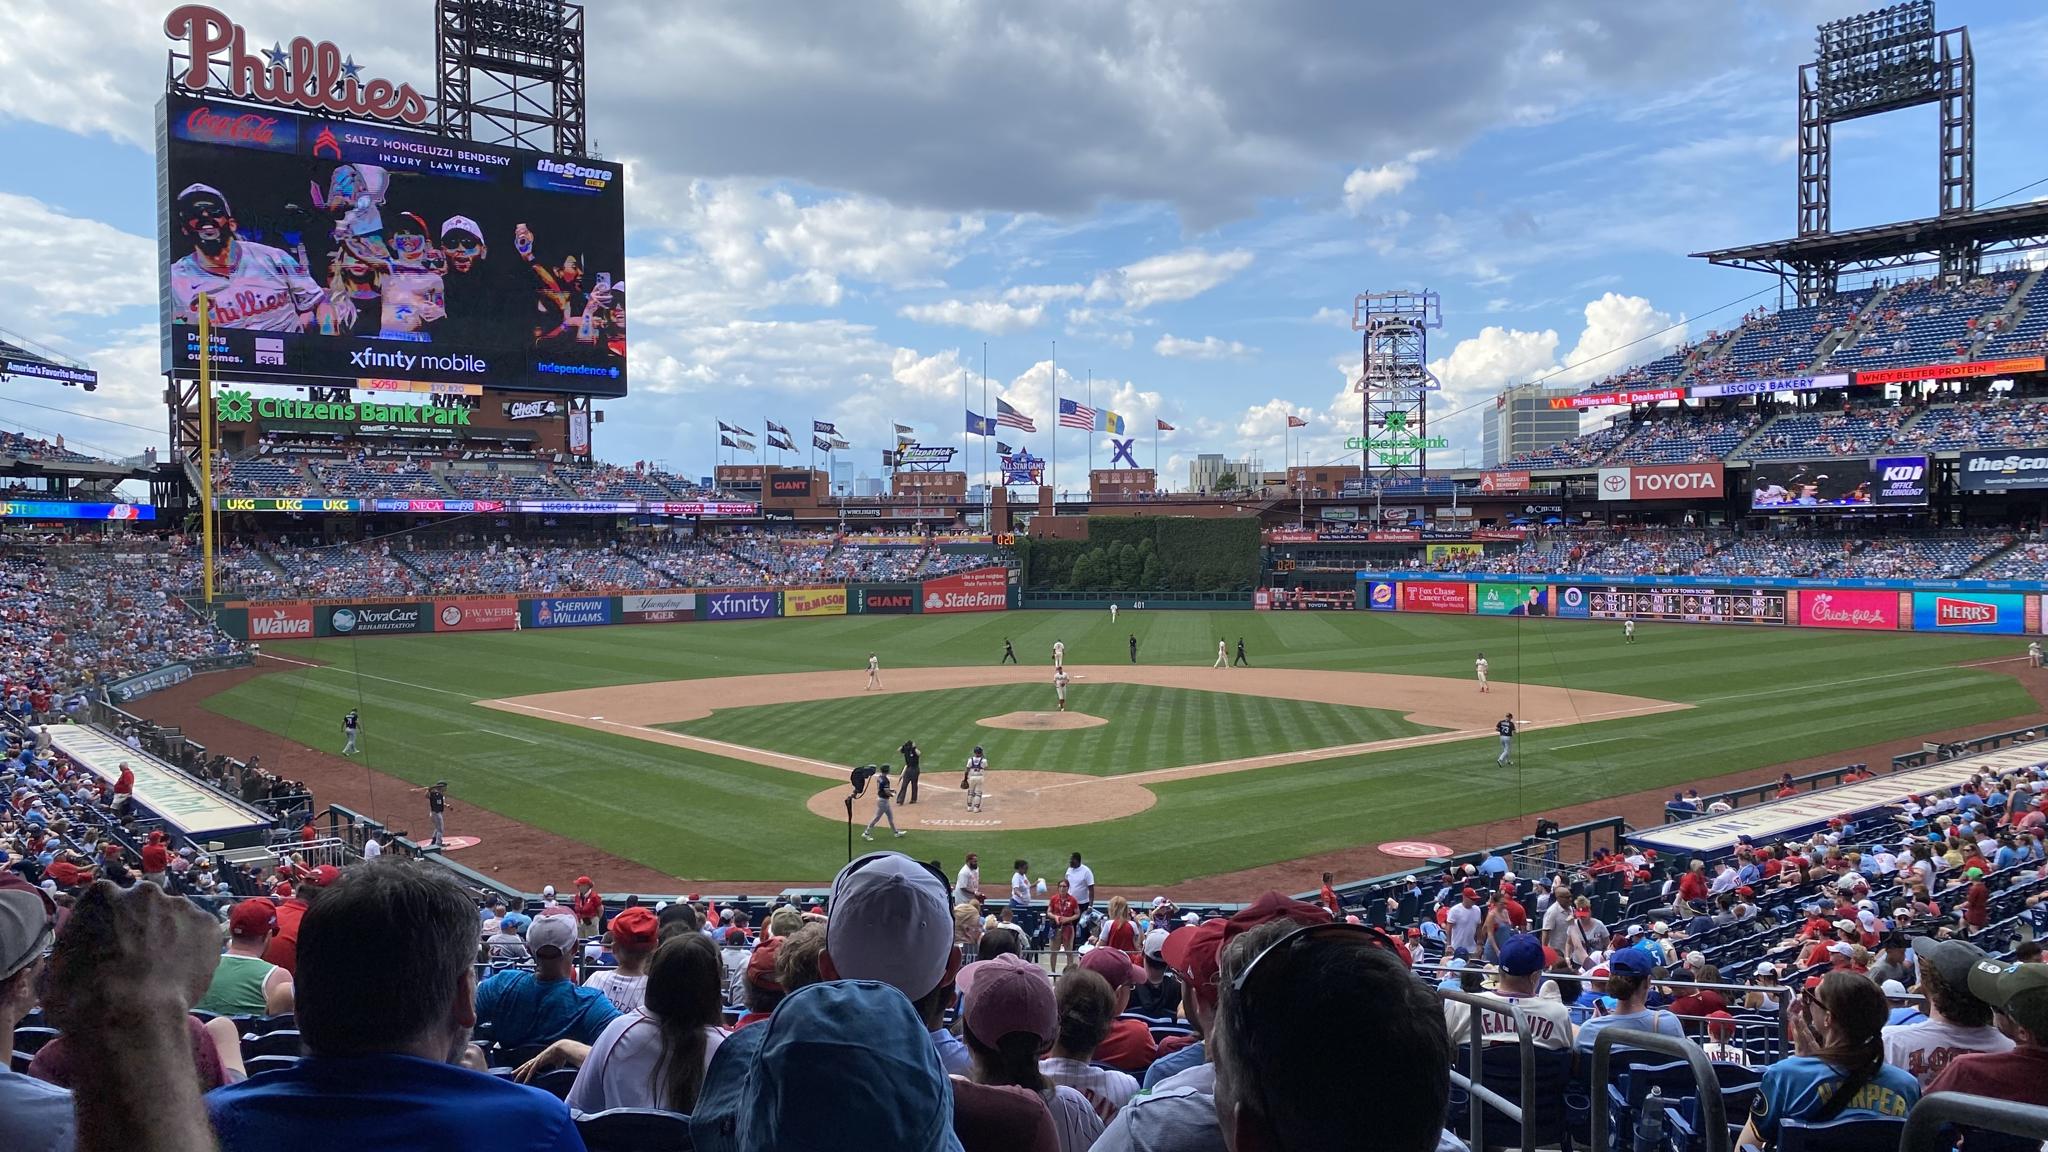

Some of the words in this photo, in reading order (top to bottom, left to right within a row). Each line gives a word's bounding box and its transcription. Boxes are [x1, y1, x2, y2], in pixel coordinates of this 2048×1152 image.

[164, 5, 428, 125] Phillies
[187, 107, 278, 143] Coca-Cola
[345, 133, 378, 147] SALTZ
[383, 140, 453, 158] MONGELUZZI
[457, 150, 511, 167] BENDESKY
[379, 153, 421, 167] INJURY
[430, 161, 481, 175] LAWYERS
[537, 159, 613, 181] theScore
[188, 333, 226, 345] Dring
[188, 344, 230, 352] smrter
[188, 353, 243, 363] oucomes.
[350, 347, 416, 371] xfinity
[421, 353, 486, 373] mobile
[7, 361, 42, 375] America's
[42, 368, 70, 380] Favorite
[70, 371, 96, 383] Beaches
[538, 362, 607, 377] Independence
[1862, 371, 1894, 382] WHEY
[1898, 367, 1935, 379] BETTER
[1938, 364, 1987, 376] PROTEIN
[1721, 382, 1766, 394] LISCIO'S
[1769, 378, 1814, 391] BAKERY
[1572, 396, 1600, 407] Phillies
[1601, 396, 1615, 405] win
[1631, 392, 1654, 402] Deals
[1655, 390, 1669, 400] roll
[1669, 390, 1678, 399] in
[257, 396, 355, 422] Citizens
[360, 401, 418, 424] Bank
[421, 404, 472, 426] Park
[511, 401, 546, 420] GHOST
[1347, 435, 1407, 450] Citizens
[1410, 435, 1447, 449] Bank
[1379, 452, 1413, 465] Park
[1883, 465, 1923, 481] KDI
[774, 481, 808, 489] GIANT
[1635, 472, 1716, 491] TOYOTA
[1891, 481, 1913, 489] OFFICE
[1882, 487, 1924, 497] TECHNOLOGY
[227, 499, 255, 510] UKG
[275, 499, 303, 510] UKG
[322, 499, 349, 510] UKG
[667, 504, 702, 512] TOYOTA
[721, 504, 753, 513] TOYOTA
[1419, 587, 1434, 595] Fox
[1435, 588, 1456, 596] Chase
[867, 596, 912, 607] GIANT
[1419, 593, 1440, 602] Cancer
[1441, 594, 1464, 603] Center
[1654, 595, 1663, 603] ATH
[1753, 598, 1765, 606] BOS
[554, 600, 602, 612] SHERWIN
[711, 594, 771, 616] xfinity
[1134, 601, 1145, 610] 401
[357, 608, 419, 623] NovaCare
[484, 607, 514, 616] WEBB
[645, 611, 674, 620] LAGER
[1811, 600, 1885, 624] Chick-fil-A
[1942, 606, 1990, 620] HERR'S
[253, 617, 311, 635] Wawa
[357, 622, 416, 631] REHABILITATION
[1652, 950, 1662, 967] 5
